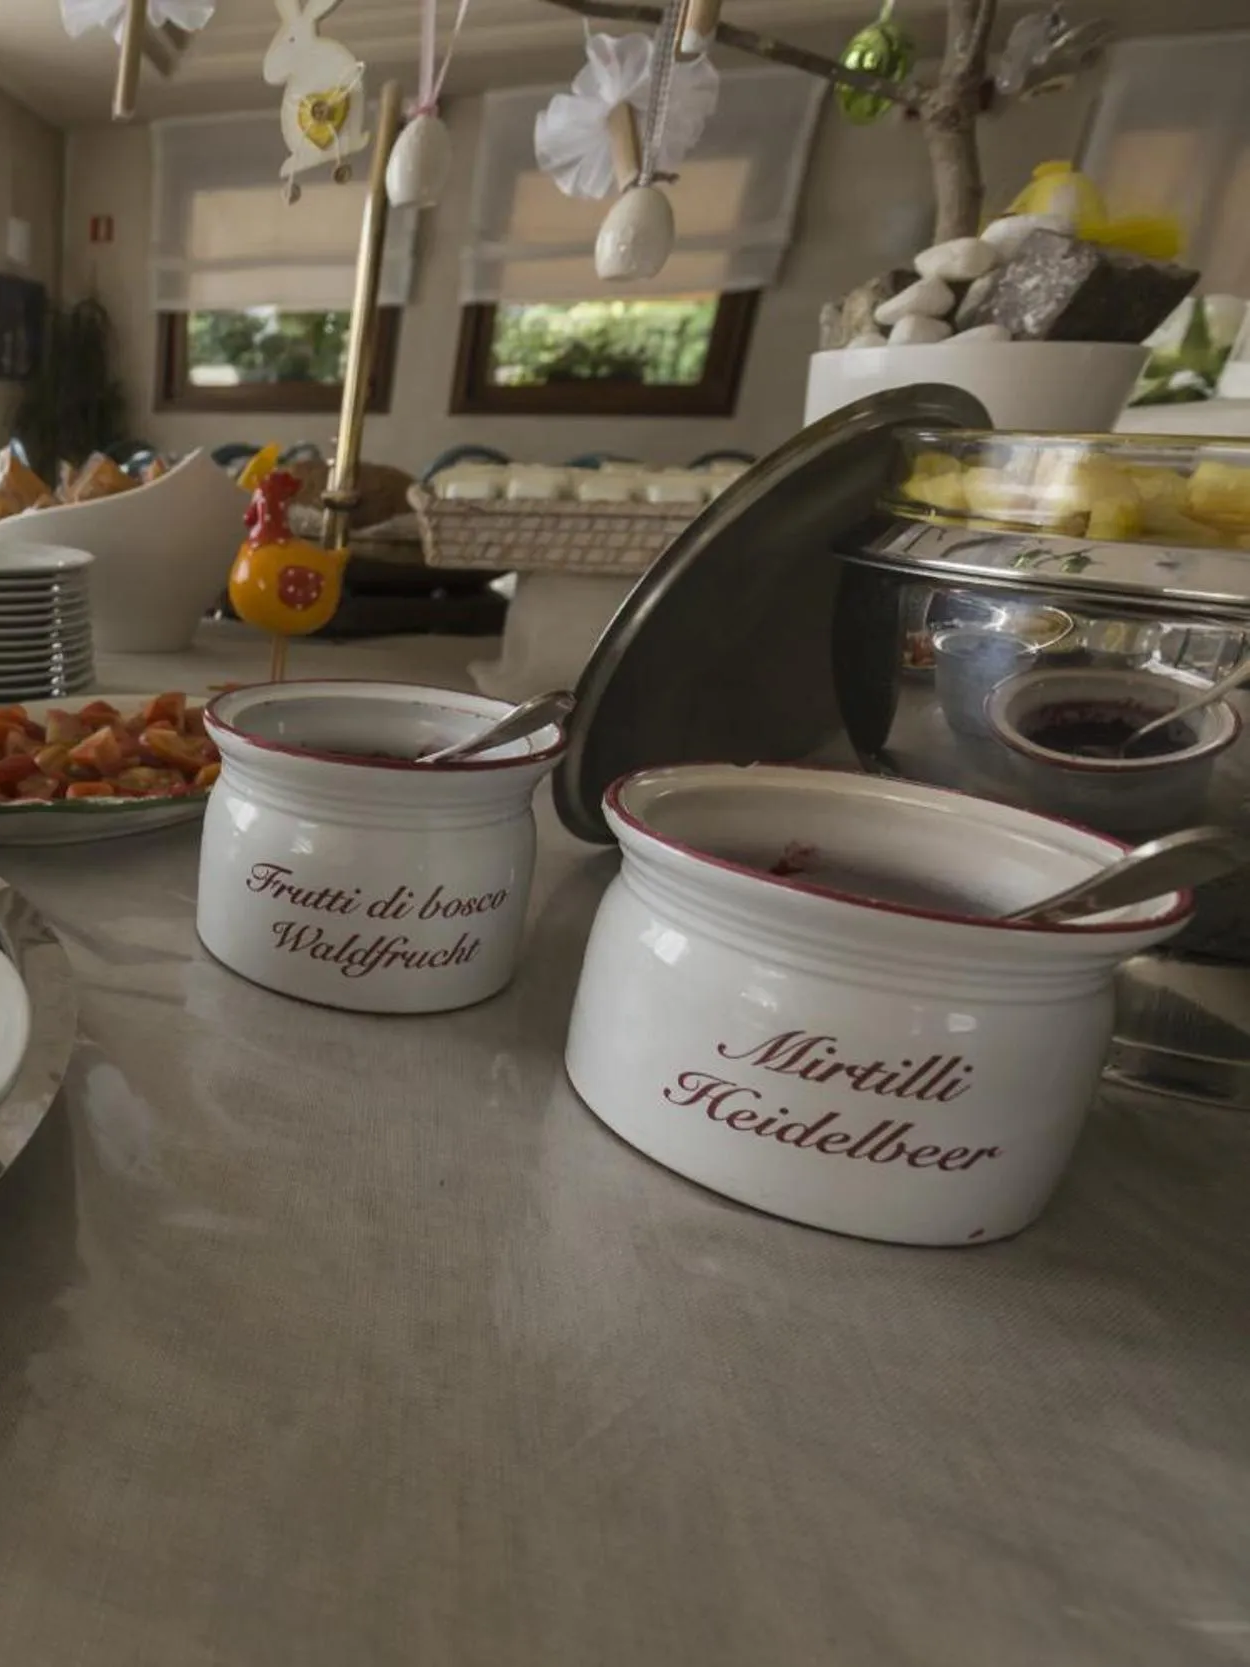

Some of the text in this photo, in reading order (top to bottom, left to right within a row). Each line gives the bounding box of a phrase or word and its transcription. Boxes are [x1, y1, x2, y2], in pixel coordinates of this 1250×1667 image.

[246, 863, 509, 920] Frutti di bosco
[272, 920, 482, 978] Waldfrucht
[717, 1030, 975, 1102] Mirtilli
[663, 1071, 1005, 1172] Heidelbeer
